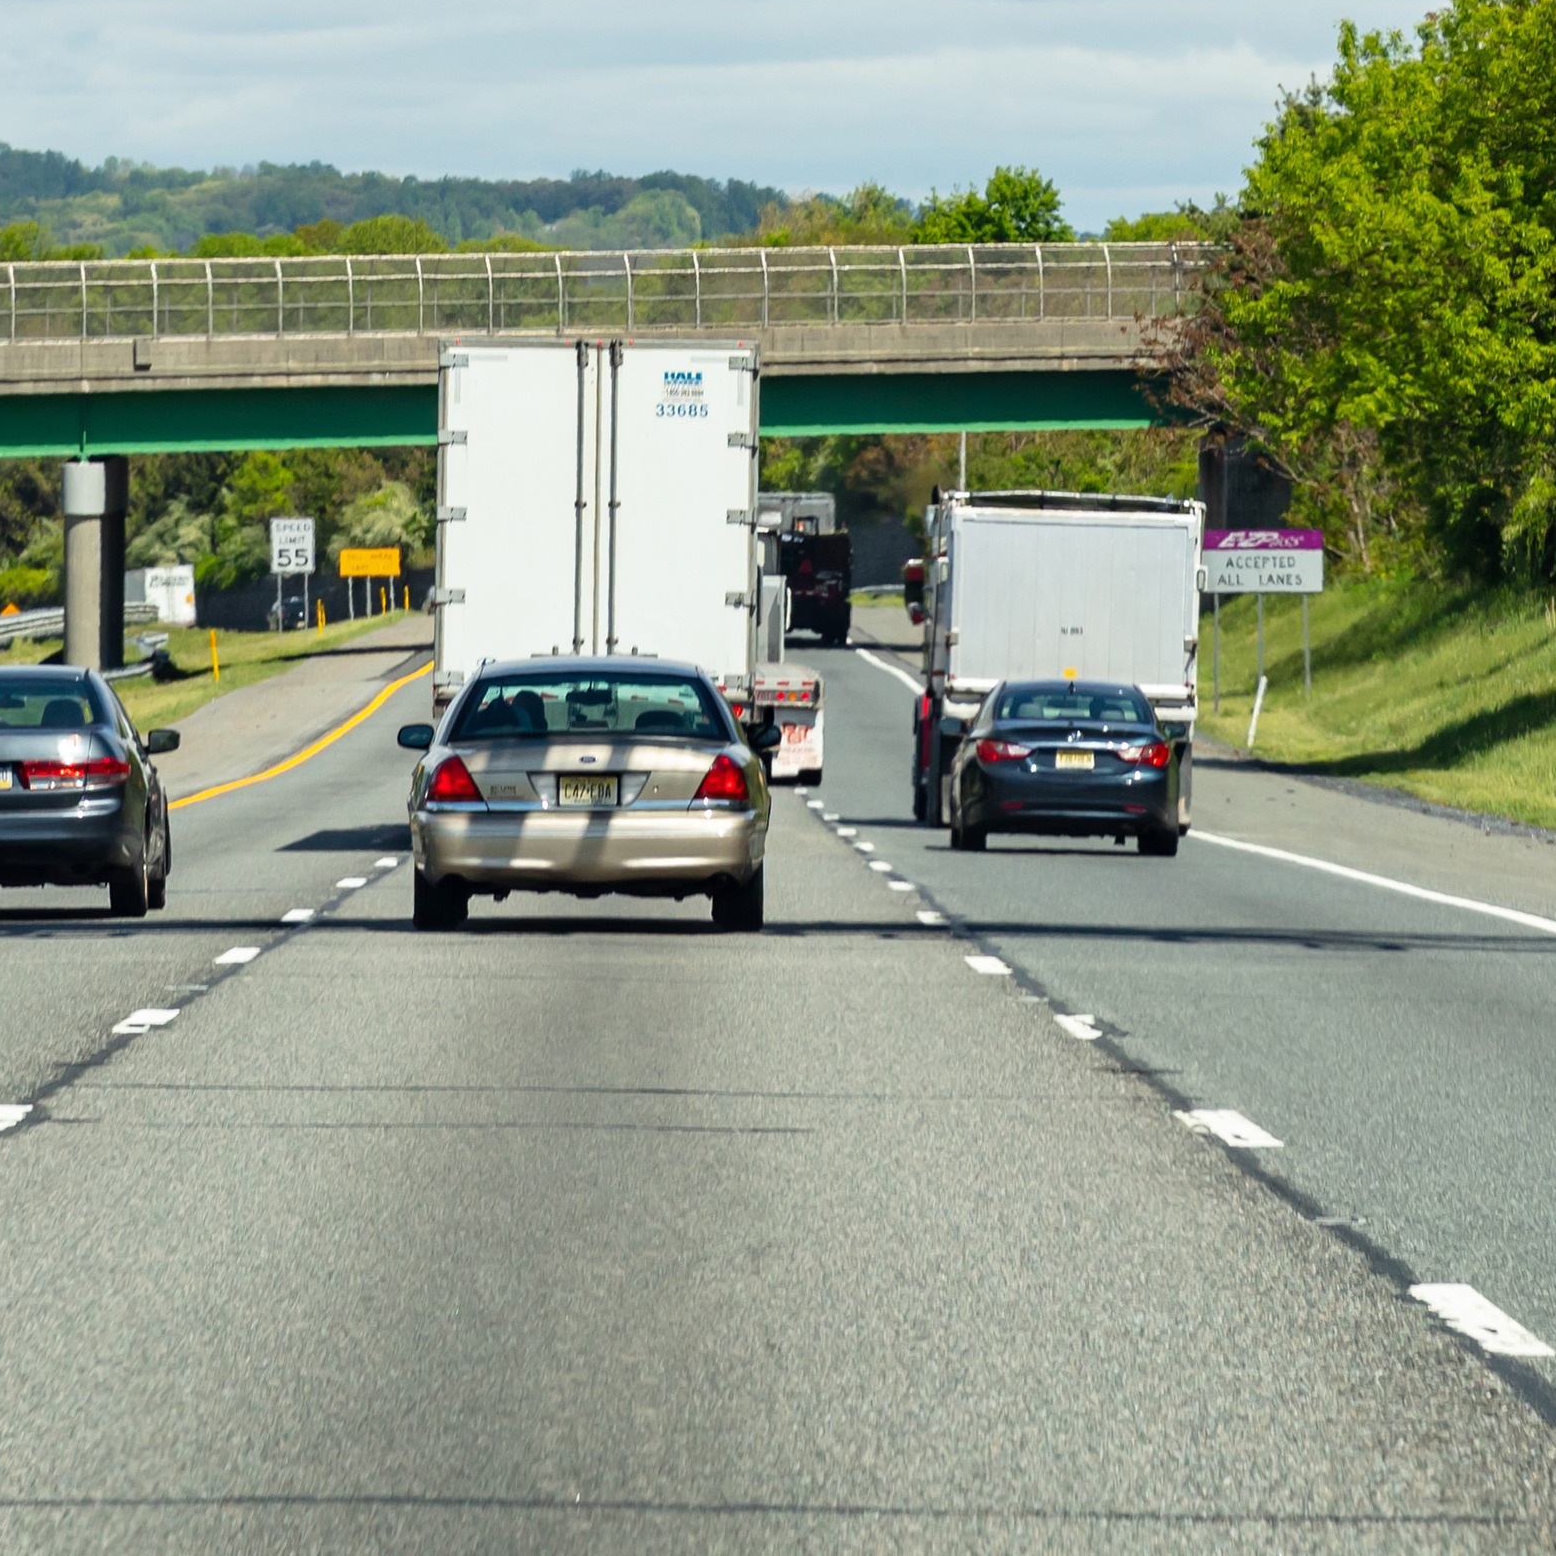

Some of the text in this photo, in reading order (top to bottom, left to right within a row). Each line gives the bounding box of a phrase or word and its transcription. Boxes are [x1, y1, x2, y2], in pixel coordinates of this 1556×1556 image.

[276, 523, 311, 532] SPEED
[279, 536, 305, 545] LIMIT
[277, 549, 308, 567] 55
[1225, 556, 1296, 569] ACCEPTED
[1217, 574, 1303, 586] ALL LANES
